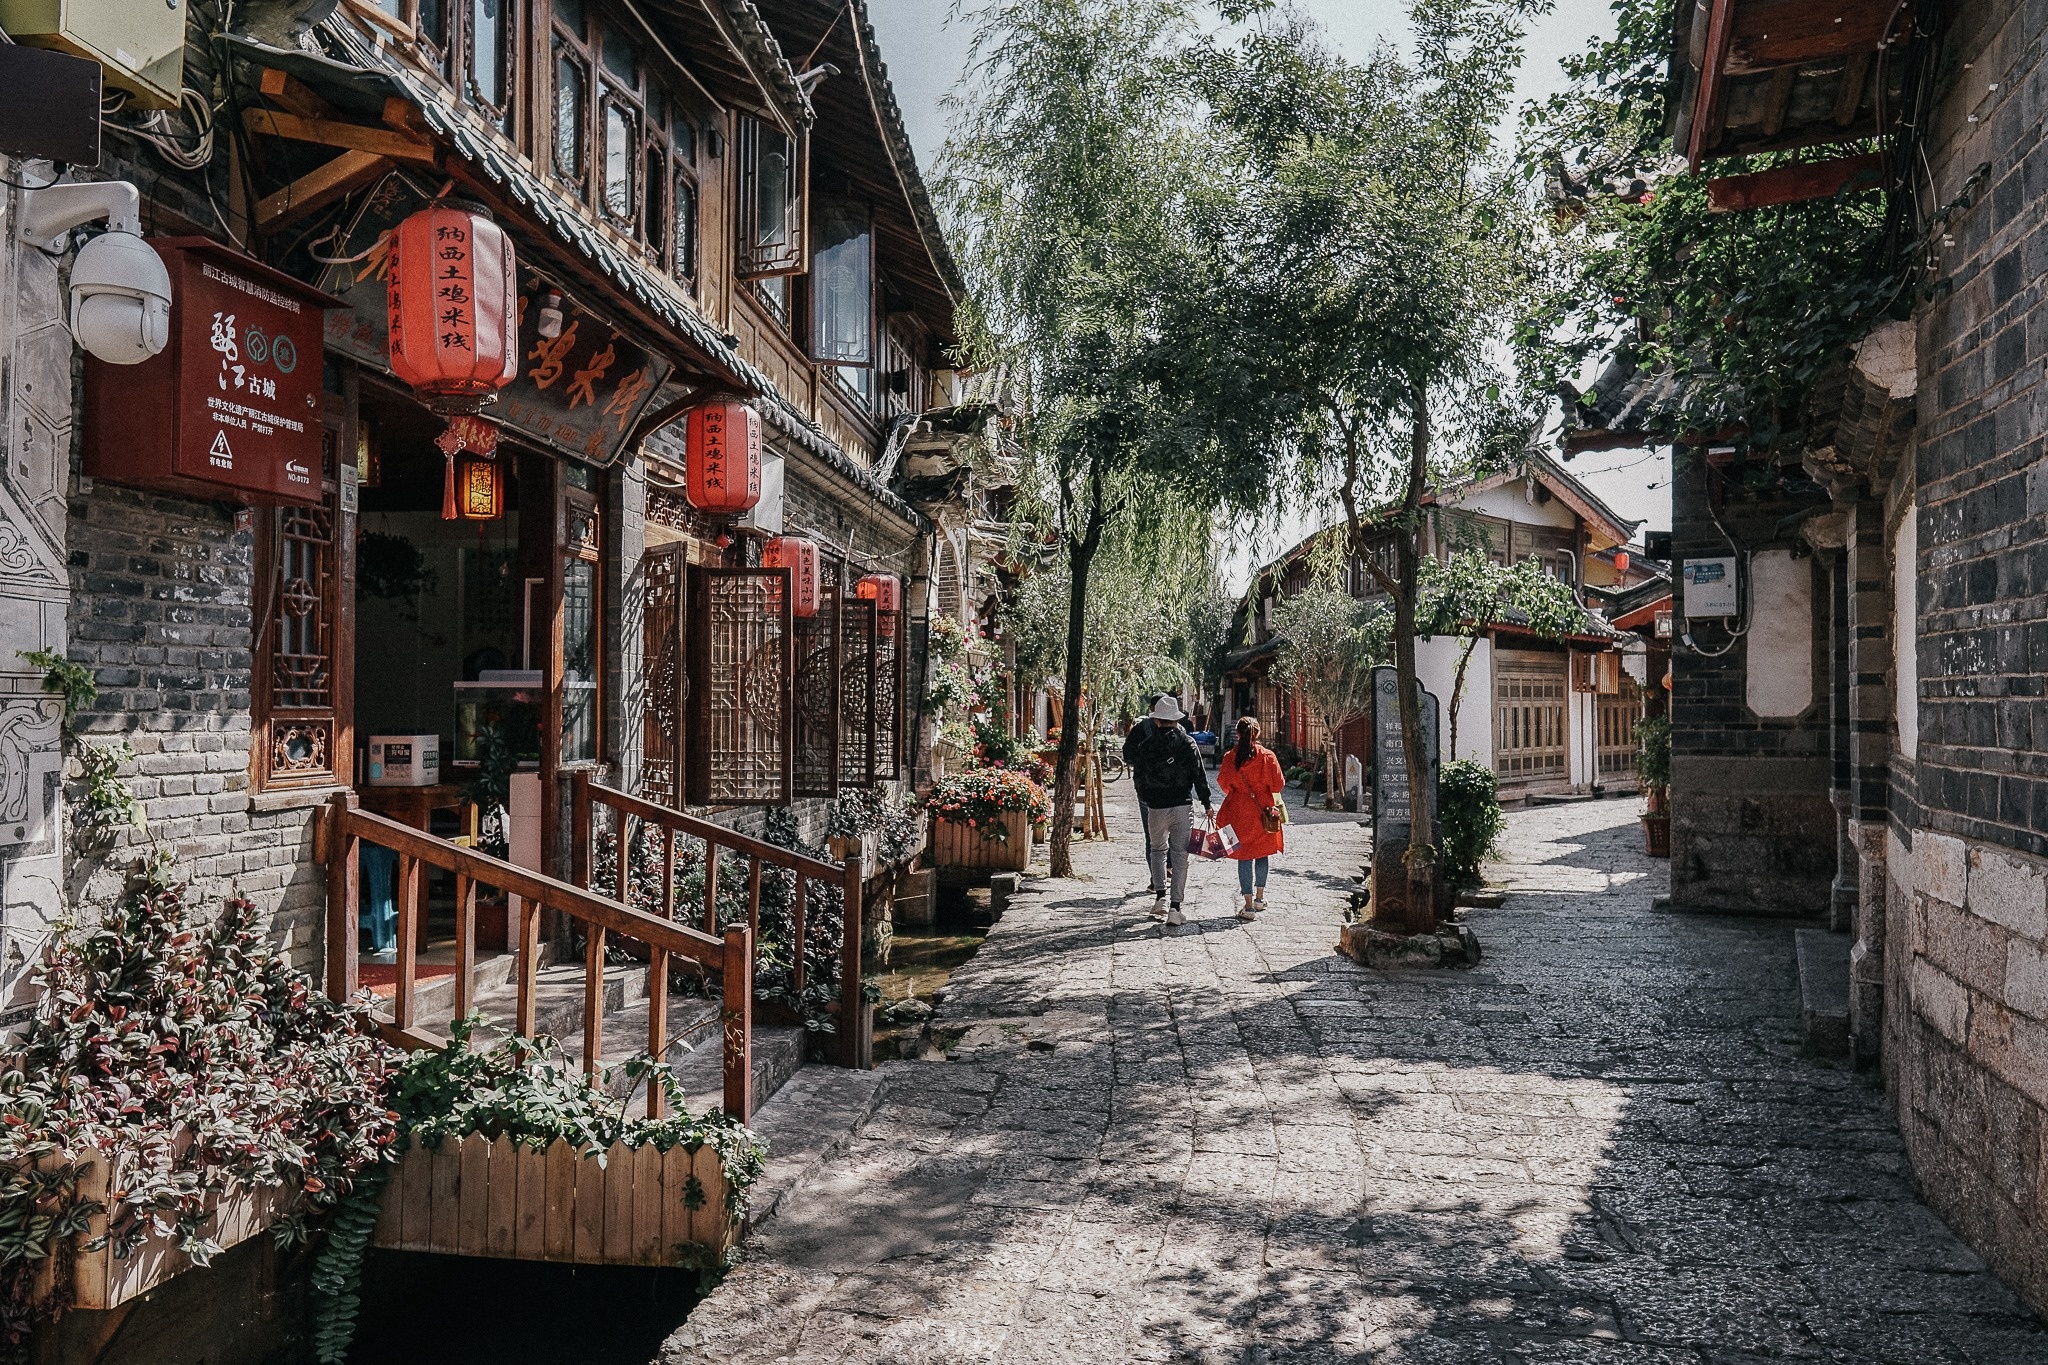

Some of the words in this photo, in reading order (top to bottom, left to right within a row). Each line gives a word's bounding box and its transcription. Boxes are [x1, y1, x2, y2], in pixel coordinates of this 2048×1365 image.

[437, 226, 471, 351] 纳西土鸡米线
[249, 374, 276, 401] 古城
[207, 396, 304, 433] 世界文化遗产丽江古城保护管理局
[212, 412, 247, 429] 非本单位人员
[705, 412, 724, 490] 纳西土鸡米线
[209, 457, 233, 470] 有电危险
[1385, 722, 1402, 731] 祥和
[1386, 740, 1403, 748] 南门
[1386, 757, 1406, 765] 兴文
[1382, 773, 1408, 782] 忠义市
